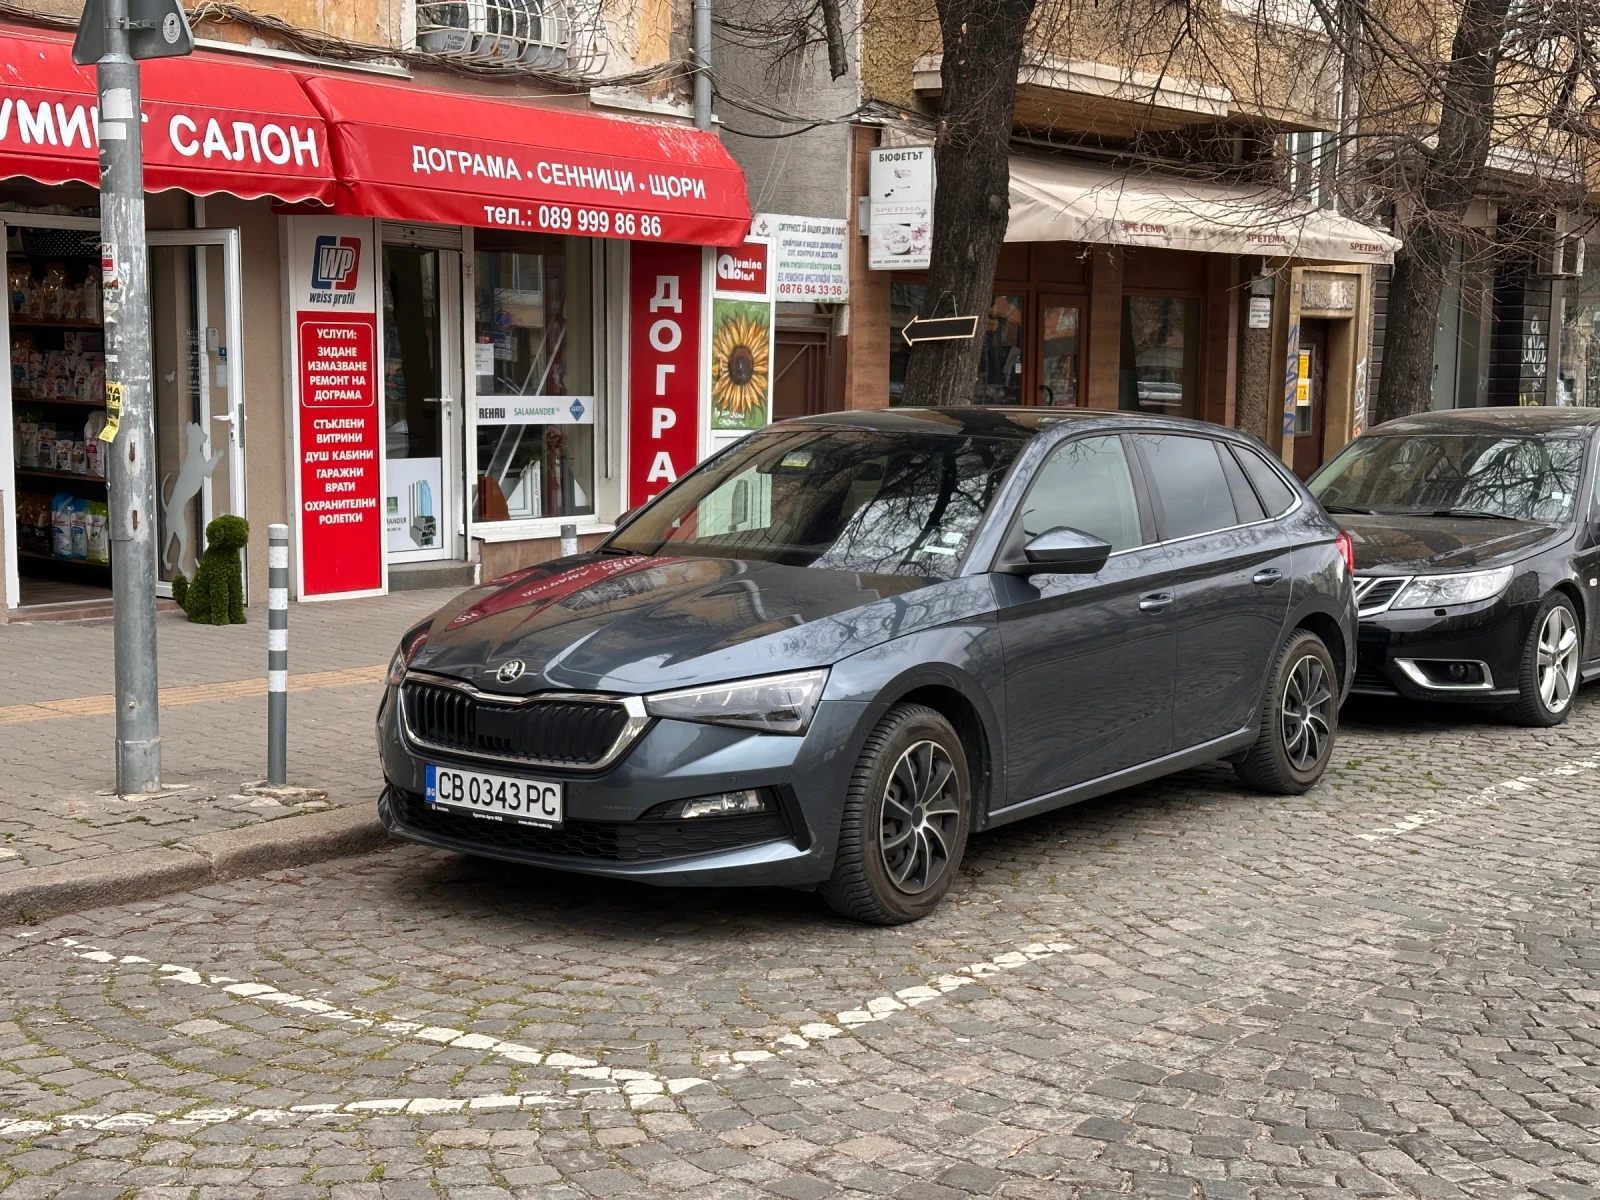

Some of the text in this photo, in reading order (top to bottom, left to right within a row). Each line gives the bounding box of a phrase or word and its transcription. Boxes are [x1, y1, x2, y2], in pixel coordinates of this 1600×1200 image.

[169, 114, 320, 168] САЛОН
[879, 151, 924, 162] БЮФЕТЪТ
[412, 145, 707, 201] ДОГРАМА СЕННИЦИ ЩОРИ
[483, 205, 662, 237] тел.: 089 999 86 86
[1121, 221, 1166, 234] SPETEMA
[778, 222, 801, 233] СИГУРНОСТ
[801, 223, 807, 233] ЗА
[807, 224, 821, 234] ВАШИЯ
[821, 225, 831, 235] ДОМ
[835, 226, 846, 236] ОФИС
[1246, 233, 1287, 244] SPETEMA
[1350, 242, 1384, 253] SPETEMA
[320, 247, 355, 281] WP
[780, 283, 842, 296] 0876 94 33 36
[309, 290, 356, 307] weiss profil
[316, 328, 357, 340] УСЛУГИ:
[317, 346, 358, 359] ЗИДАНЕ
[307, 360, 368, 372] ИЗМАЗВАНЕ
[309, 375, 367, 386] РЕМОНТ НА
[313, 389, 363, 402] ДОГРАМА
[647, 275, 683, 504] ДОГРА
[478, 407, 506, 419] REHAU
[513, 407, 556, 417] SALAMANDER
[313, 418, 365, 430] СТЪКЛЕНИ
[316, 432, 363, 444] ВИТРИНИ
[304, 449, 374, 464] ДУШ КАБИНИ
[316, 467, 364, 479] ГАРАЖНИ
[325, 481, 356, 493] ВРАТИ
[304, 497, 377, 512] ОХРАНИТЕЛНИ
[319, 512, 363, 525] РОЛЕТКИ
[439, 771, 557, 815] CB 0343 PC
